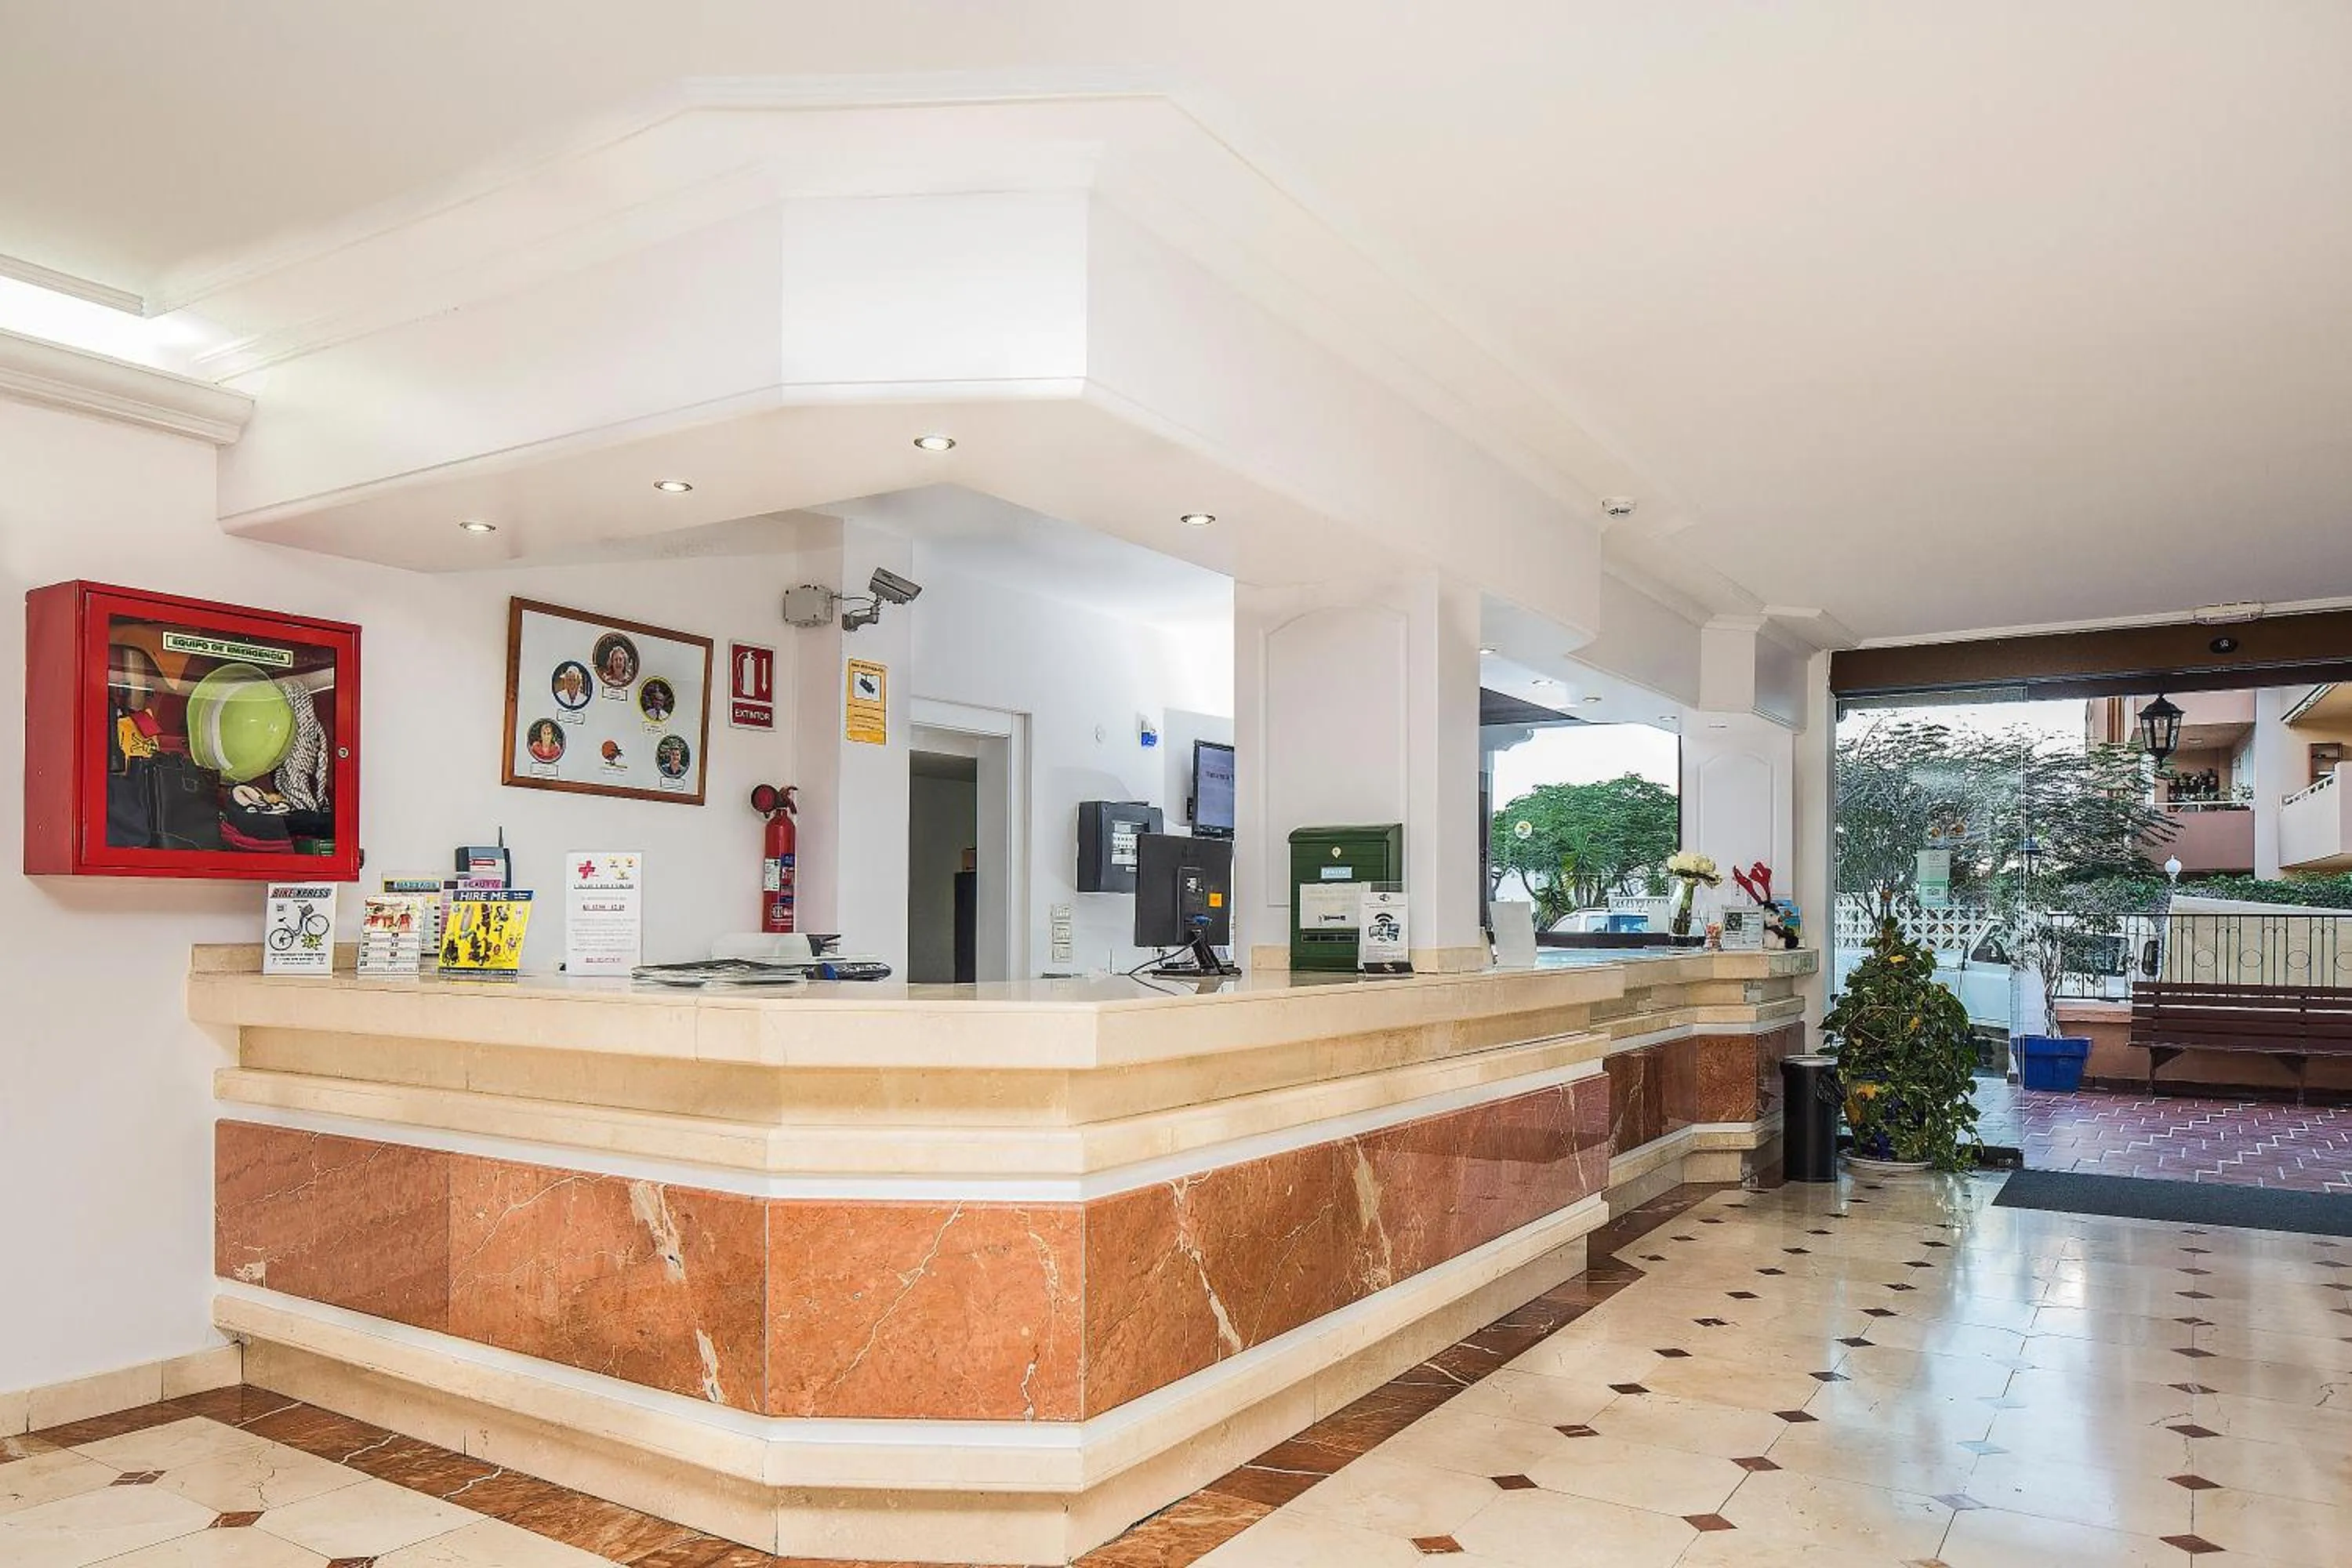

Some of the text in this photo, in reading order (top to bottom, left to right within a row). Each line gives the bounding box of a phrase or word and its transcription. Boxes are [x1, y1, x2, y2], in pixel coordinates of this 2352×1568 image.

[172, 636, 287, 661] EQUIPO DE EMERGENCIA
[735, 709, 771, 720] EXTINTOR
[459, 891, 488, 902] HIRE
[490, 891, 510, 901] ME
